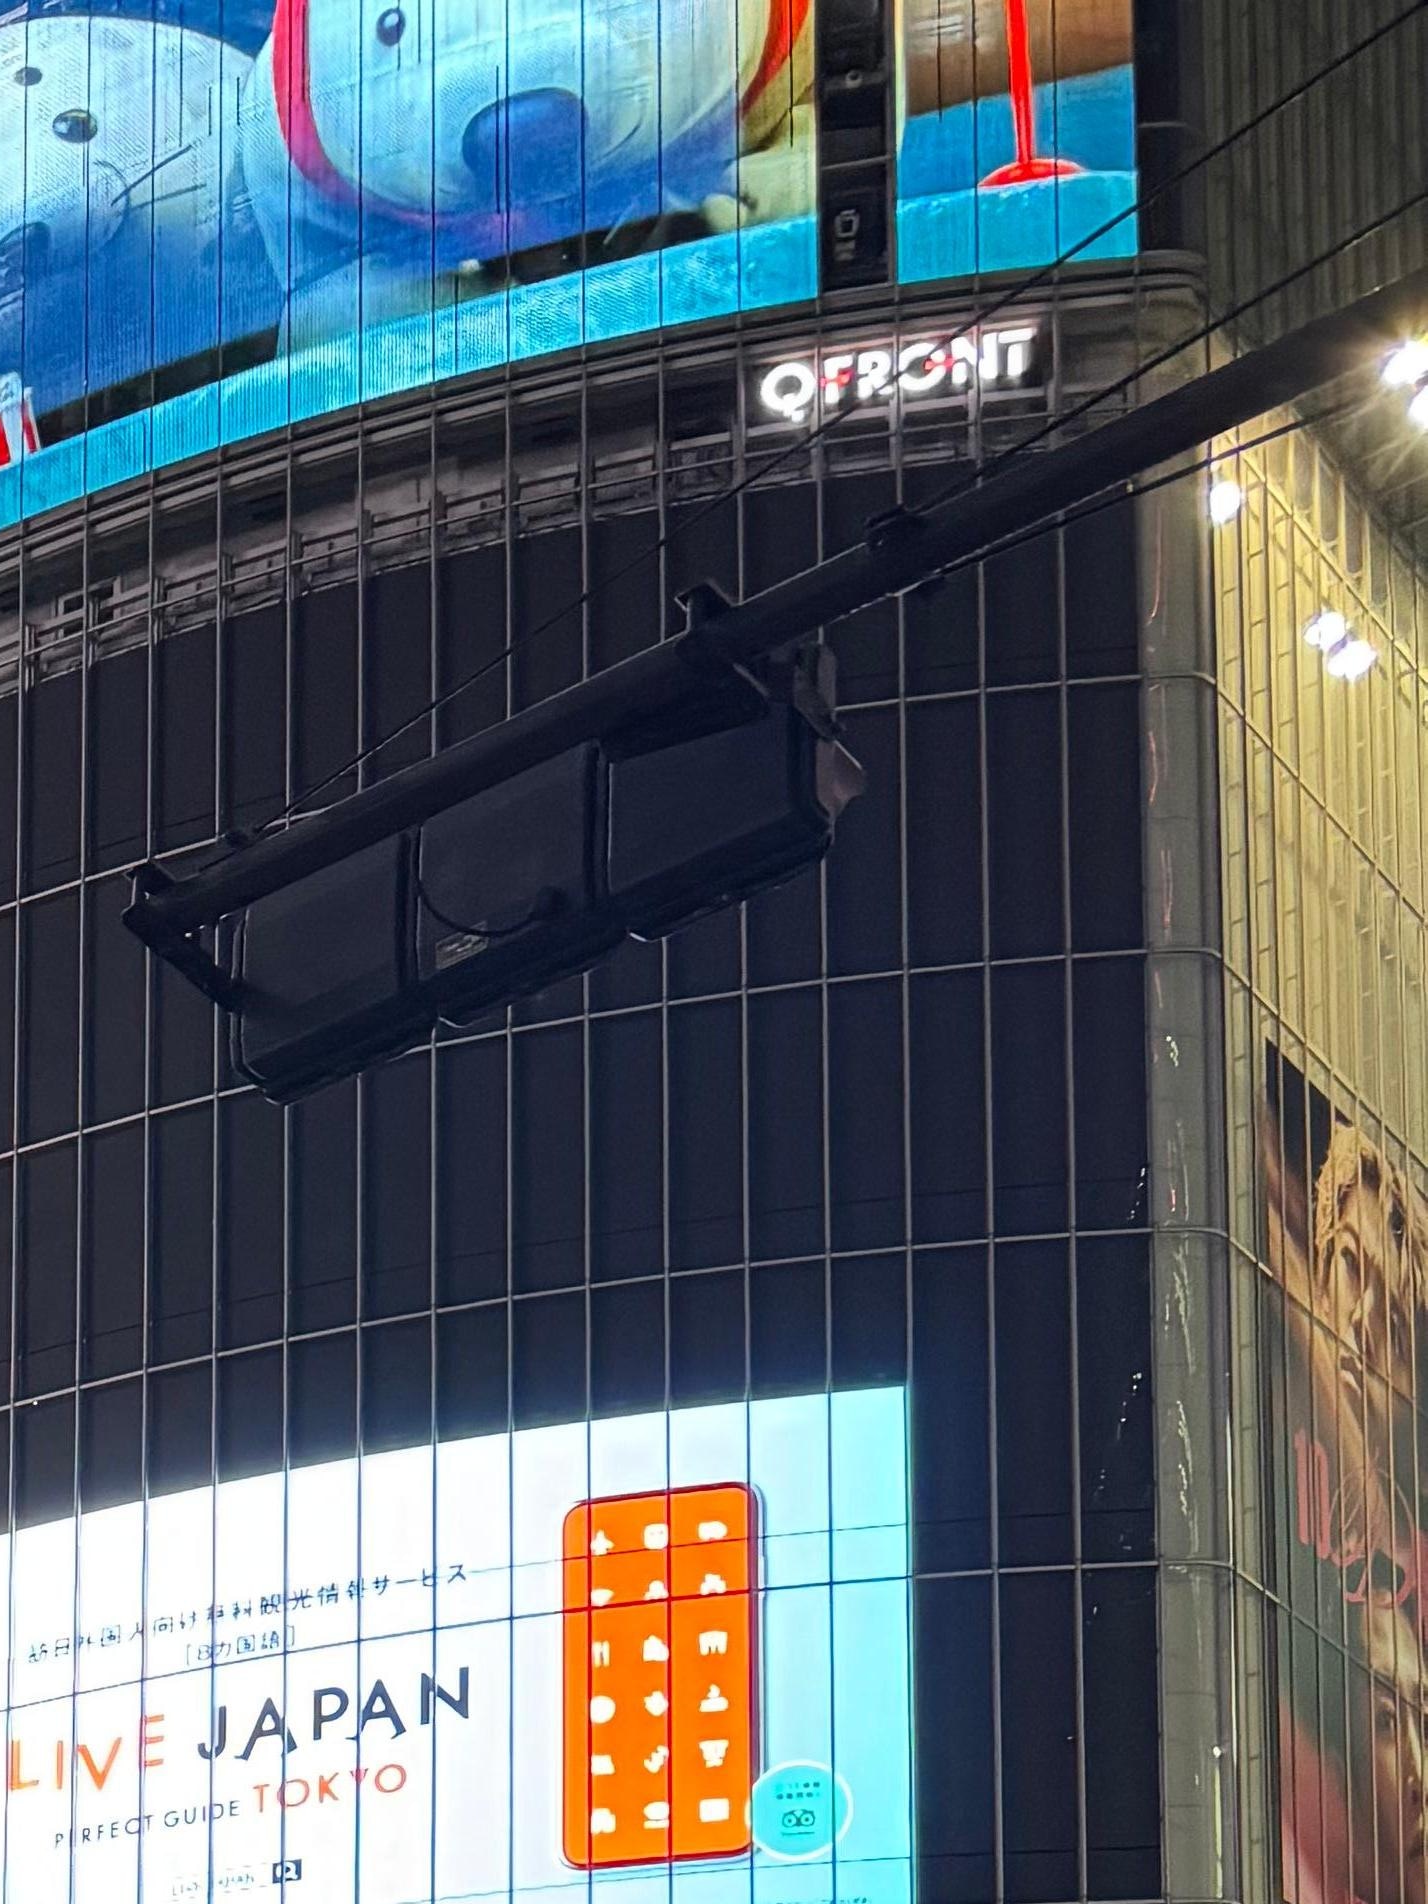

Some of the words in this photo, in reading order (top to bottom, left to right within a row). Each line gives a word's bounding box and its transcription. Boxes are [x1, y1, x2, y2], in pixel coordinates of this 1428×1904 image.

[761, 327, 1037, 422] QFRONT
[9, 1713, 165, 1791] LIVE
[197, 1667, 470, 1762] JAPAN
